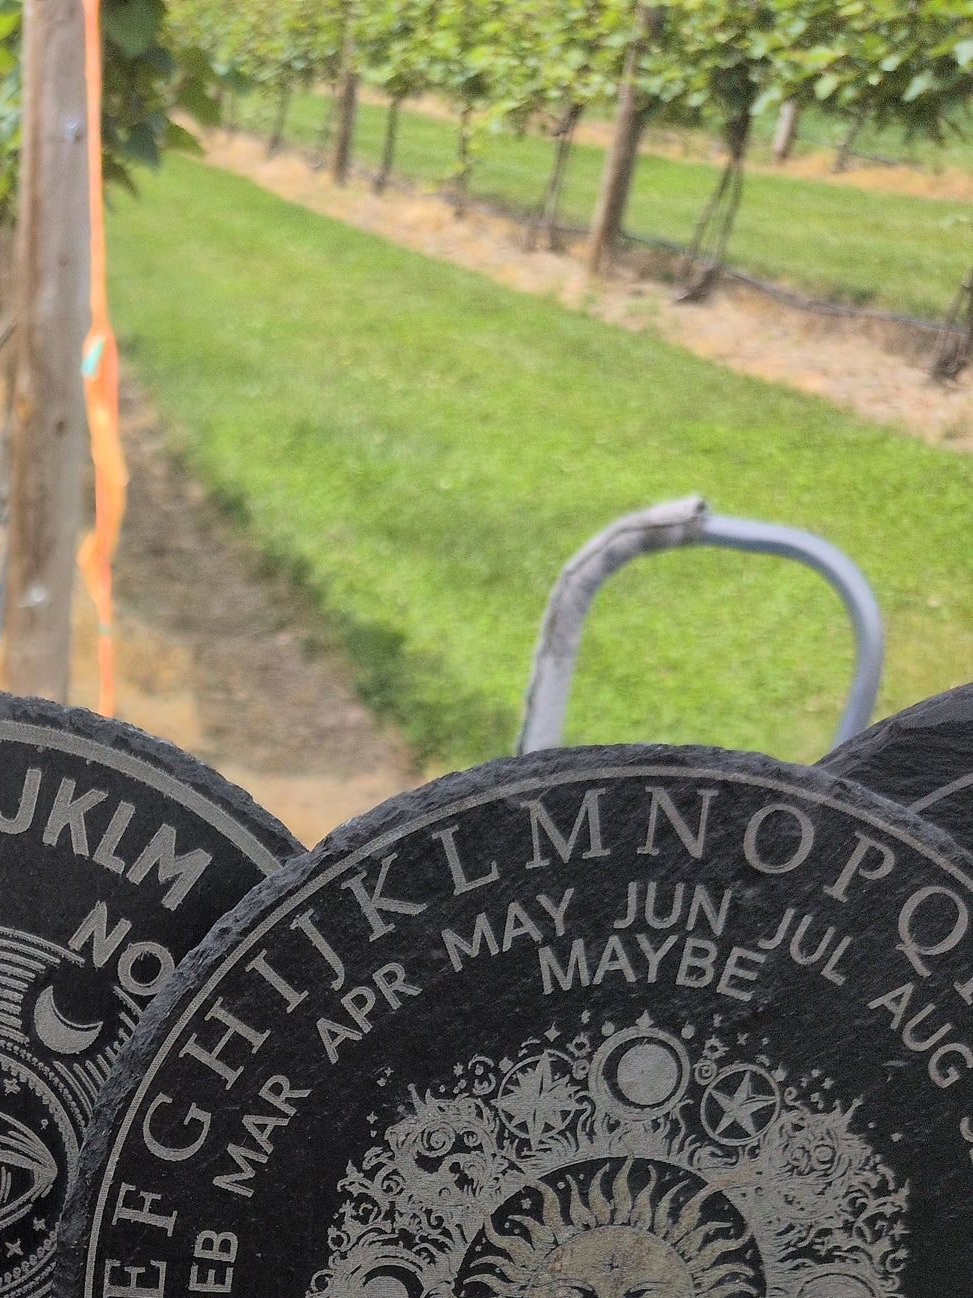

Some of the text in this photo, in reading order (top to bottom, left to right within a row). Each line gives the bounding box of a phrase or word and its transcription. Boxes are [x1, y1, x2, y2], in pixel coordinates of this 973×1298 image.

[68, 900, 176, 998] NO
[538, 933, 766, 1001] MAYBE
[212, 1074, 313, 1198] MAR
[316, 962, 423, 1065] APR
[441, 887, 575, 973] MAY
[613, 881, 733, 937] JUN
[757, 907, 853, 986] JUL
[867, 982, 973, 1089] AUG
